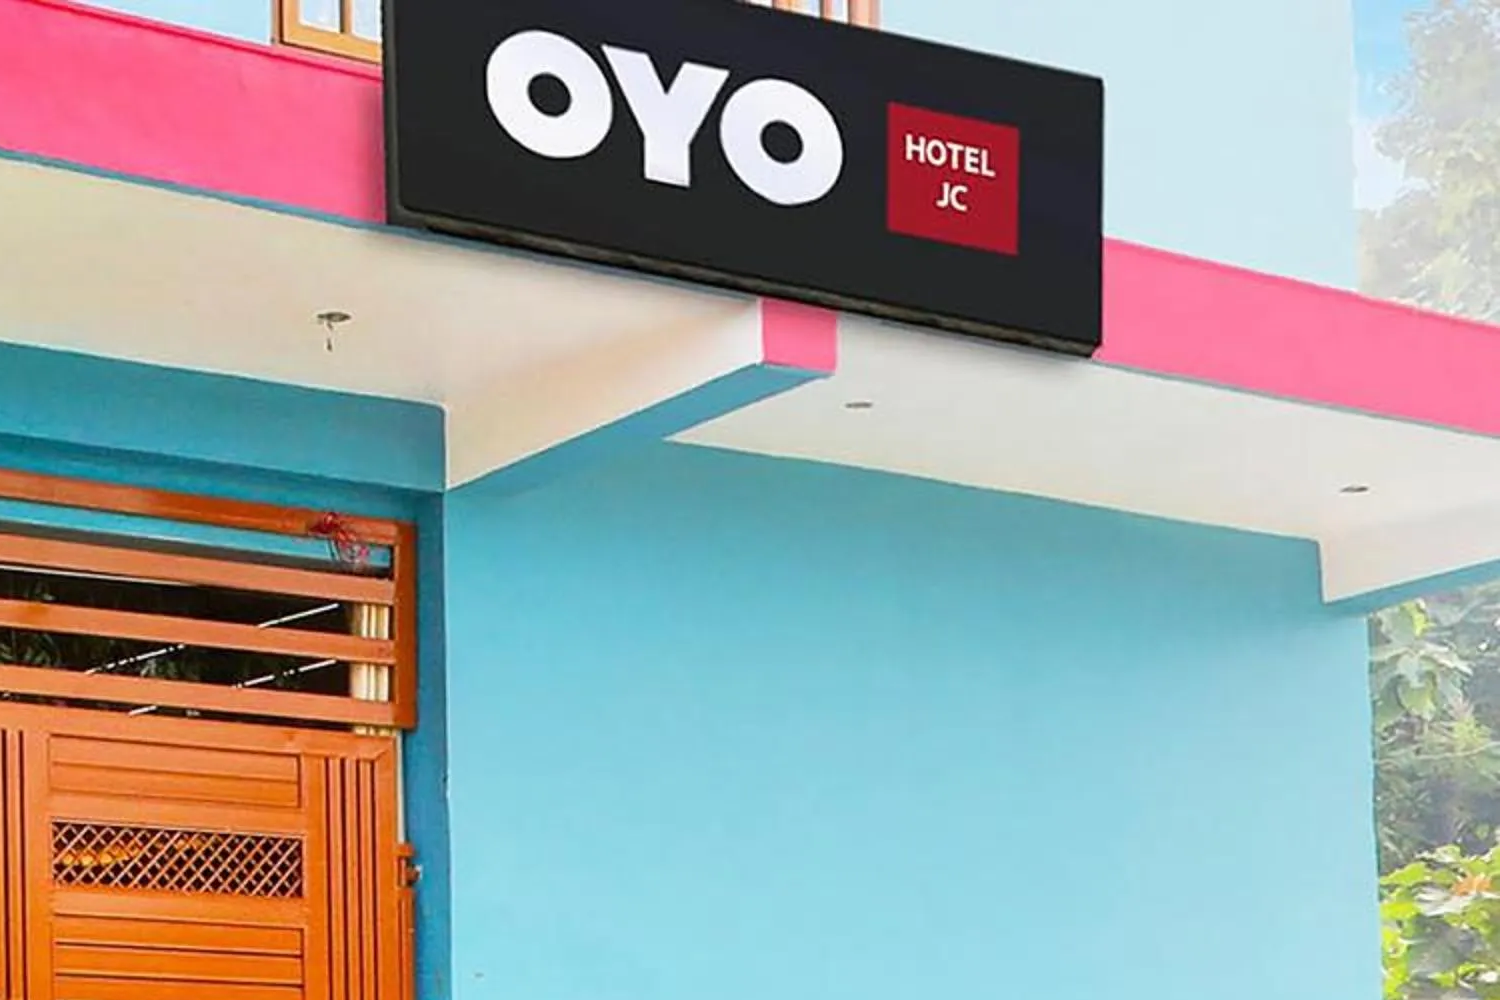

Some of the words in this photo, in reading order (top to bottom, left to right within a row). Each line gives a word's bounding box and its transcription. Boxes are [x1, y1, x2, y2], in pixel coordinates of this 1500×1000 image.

[485, 29, 843, 205] OYO
[905, 133, 997, 178] HOTEL
[936, 182, 968, 212] JC
